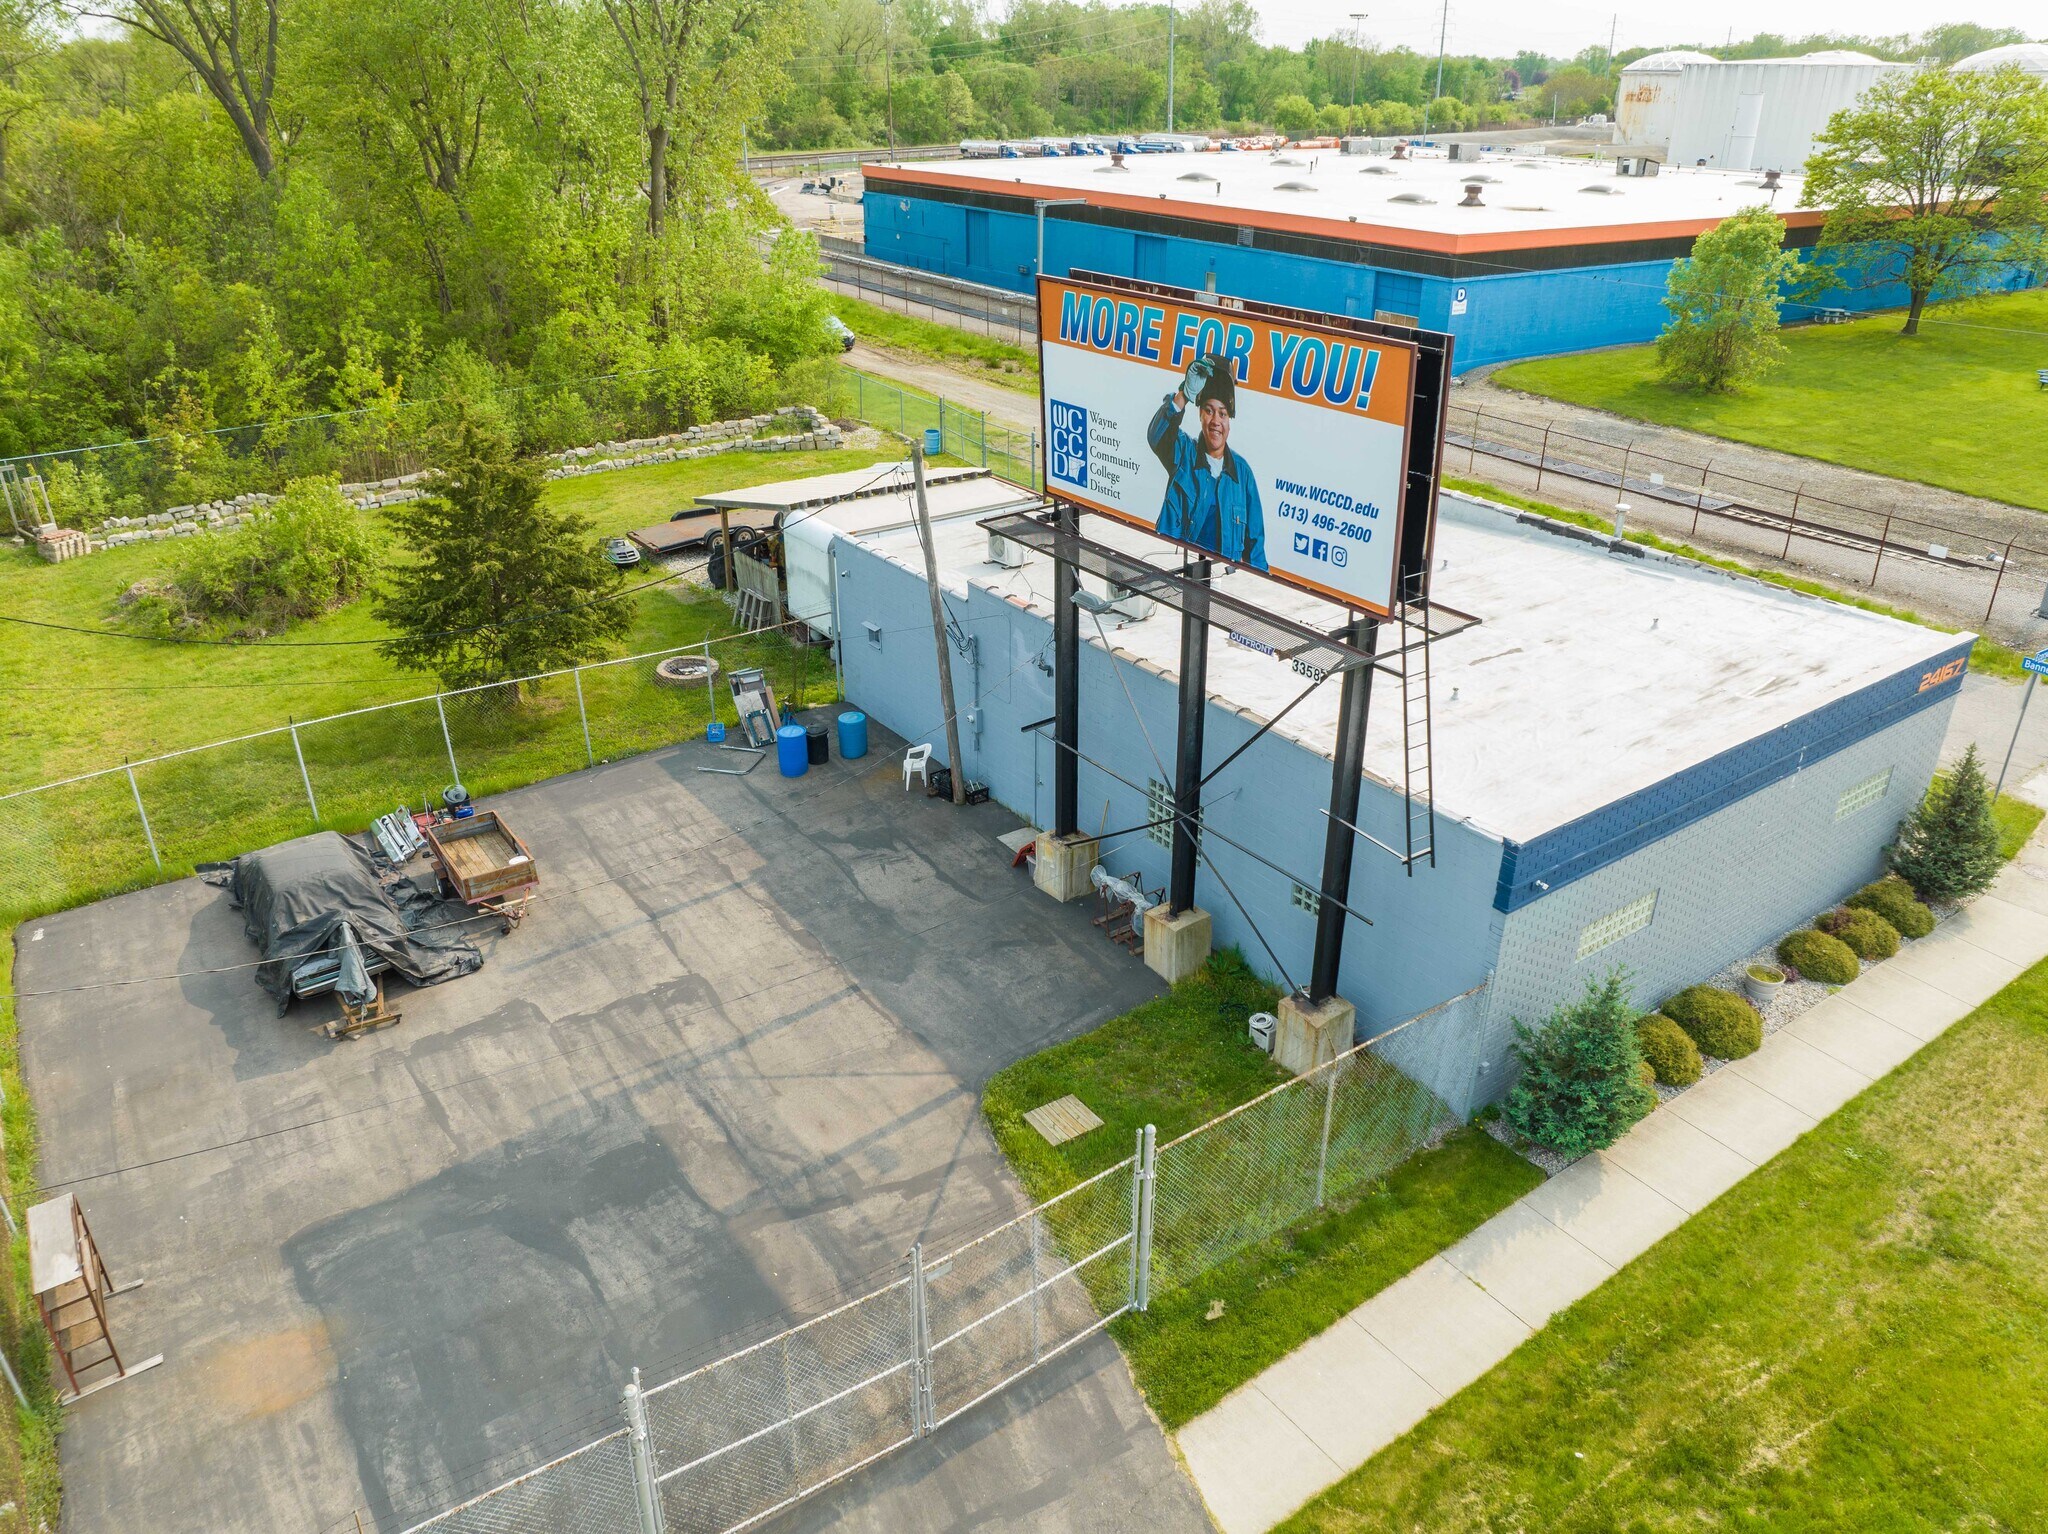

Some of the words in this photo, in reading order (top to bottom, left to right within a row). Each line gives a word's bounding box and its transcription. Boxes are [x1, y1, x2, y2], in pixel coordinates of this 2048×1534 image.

[1059, 290, 1165, 362] MORE
[1171, 312, 1255, 383] FOR
[1269, 330, 1381, 411] YOU!
[1089, 410, 1118, 430] Wayne
[1089, 428, 1121, 452] County
[1089, 445, 1141, 475] Community
[1089, 462, 1121, 485] College
[1090, 478, 1121, 500] District
[1275, 478, 1379, 520] www.WCCCD.edu
[1278, 501, 1309, 525] (313)
[1311, 513, 1372, 544] 496-2600
[1230, 631, 1273, 656] OUTFRONT
[1292, 659, 1320, 681] 3358
[1918, 657, 1966, 692] 24167
